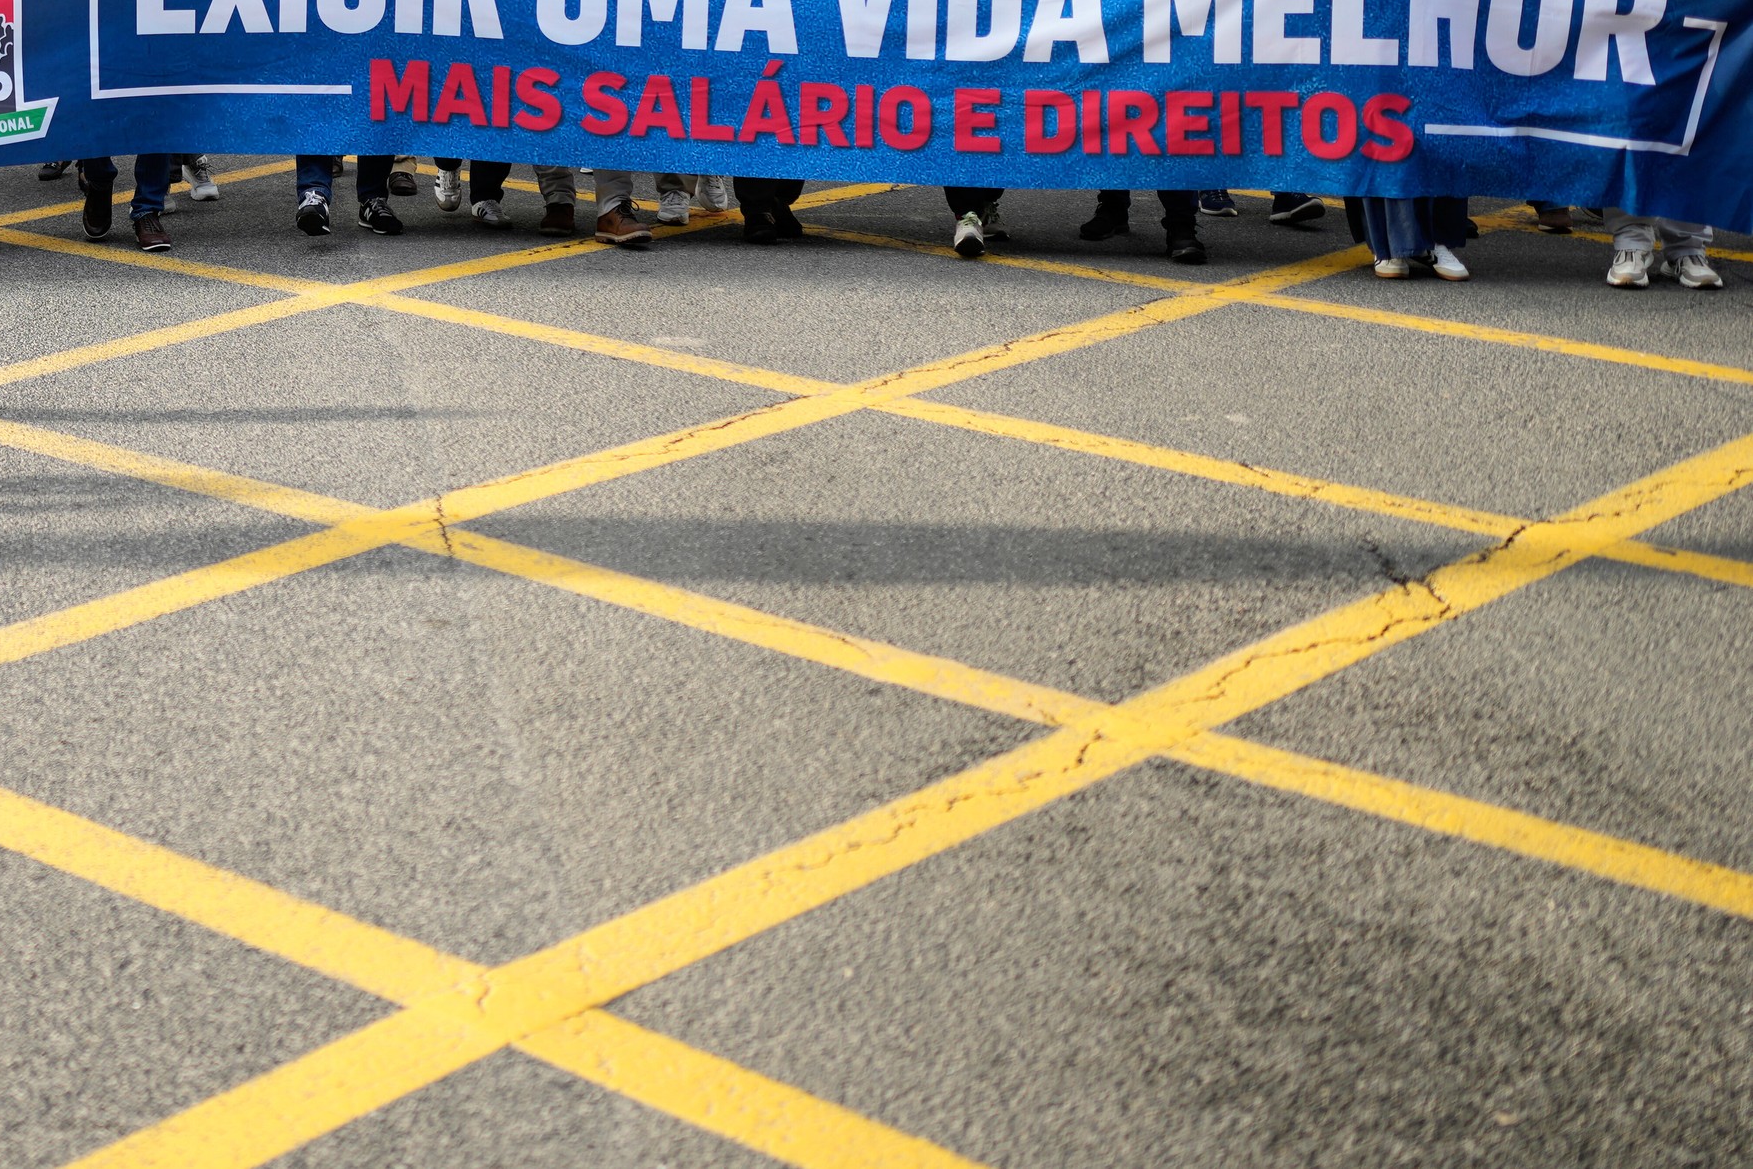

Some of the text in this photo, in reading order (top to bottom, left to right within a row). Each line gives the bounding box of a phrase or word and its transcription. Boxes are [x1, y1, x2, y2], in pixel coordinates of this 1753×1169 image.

[369, 58, 1415, 162] MAIS SALÁRIO E DIREITOS
